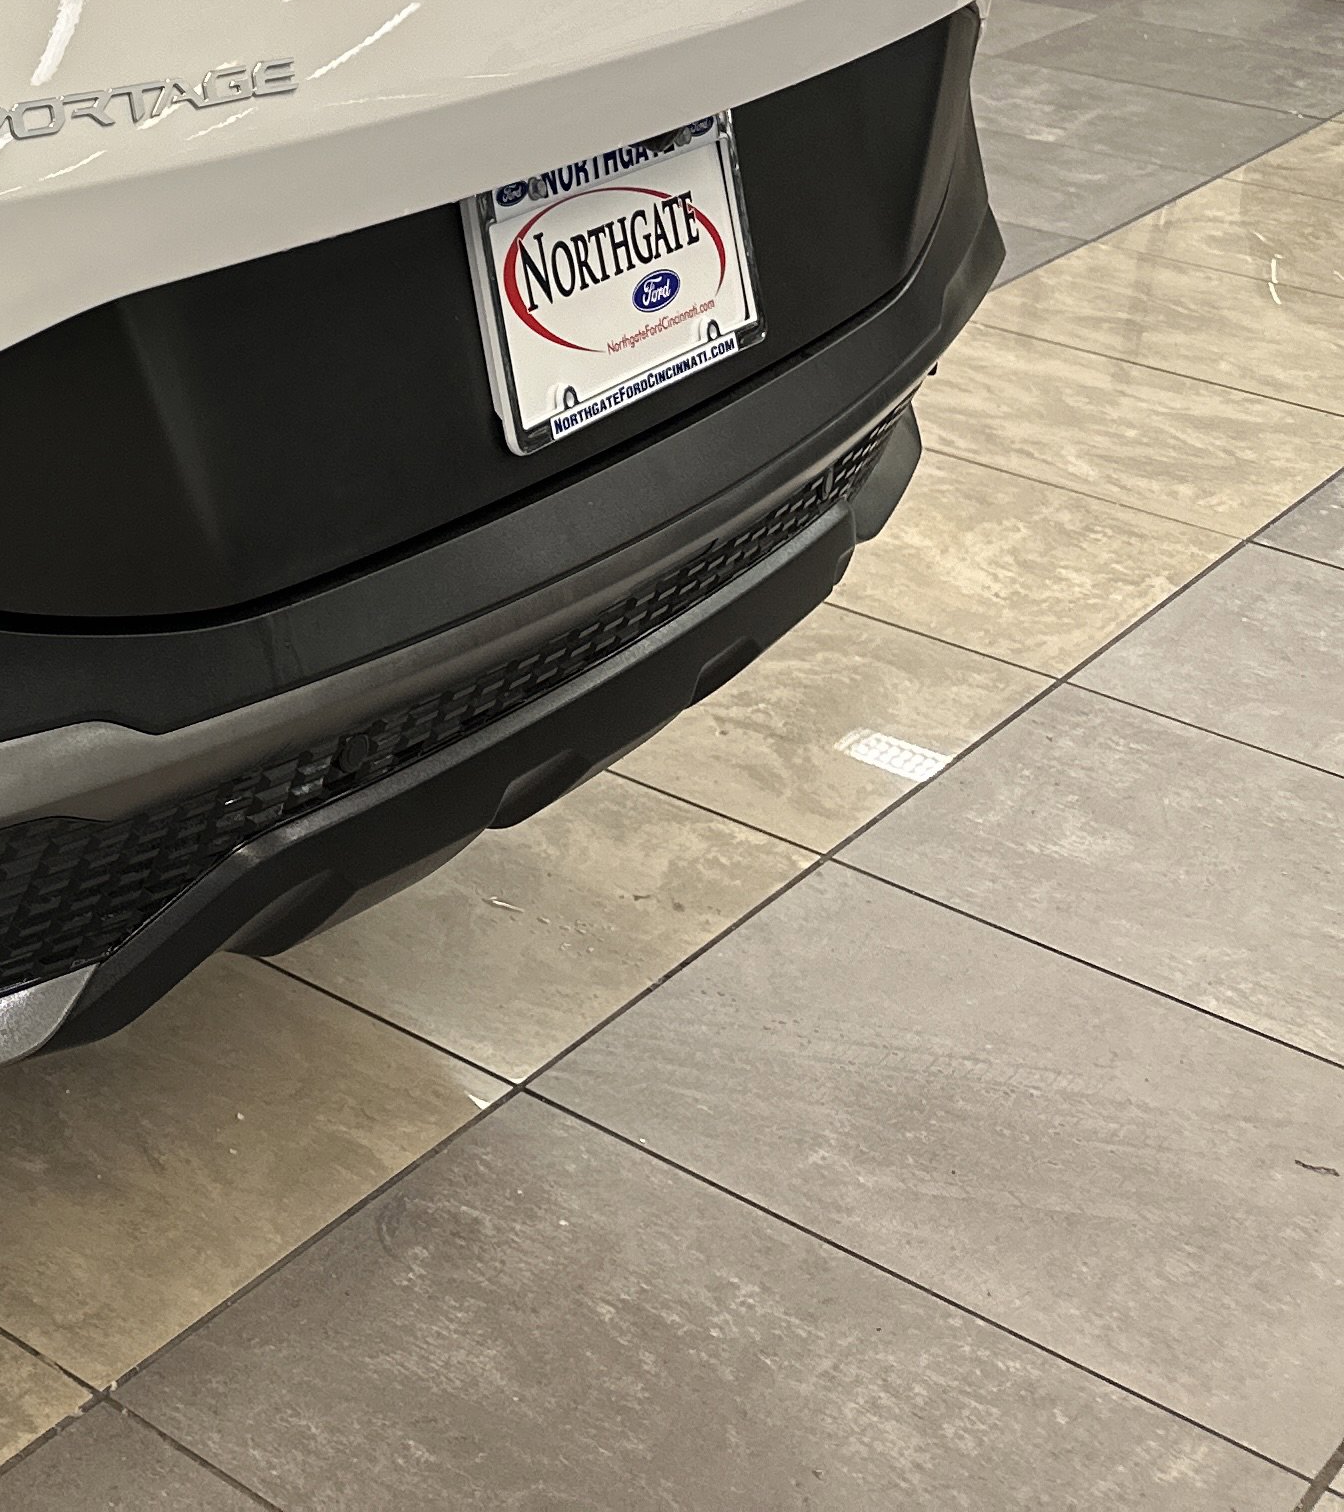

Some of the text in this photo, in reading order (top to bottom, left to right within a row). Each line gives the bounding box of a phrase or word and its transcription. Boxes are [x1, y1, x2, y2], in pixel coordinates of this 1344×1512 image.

[517, 190, 701, 313] NORTHGATE
[606, 298, 716, 356] NorthgateFordCincinnati.com
[553, 338, 736, 435] NORTHGATEFORDCINCINNATI.COM
